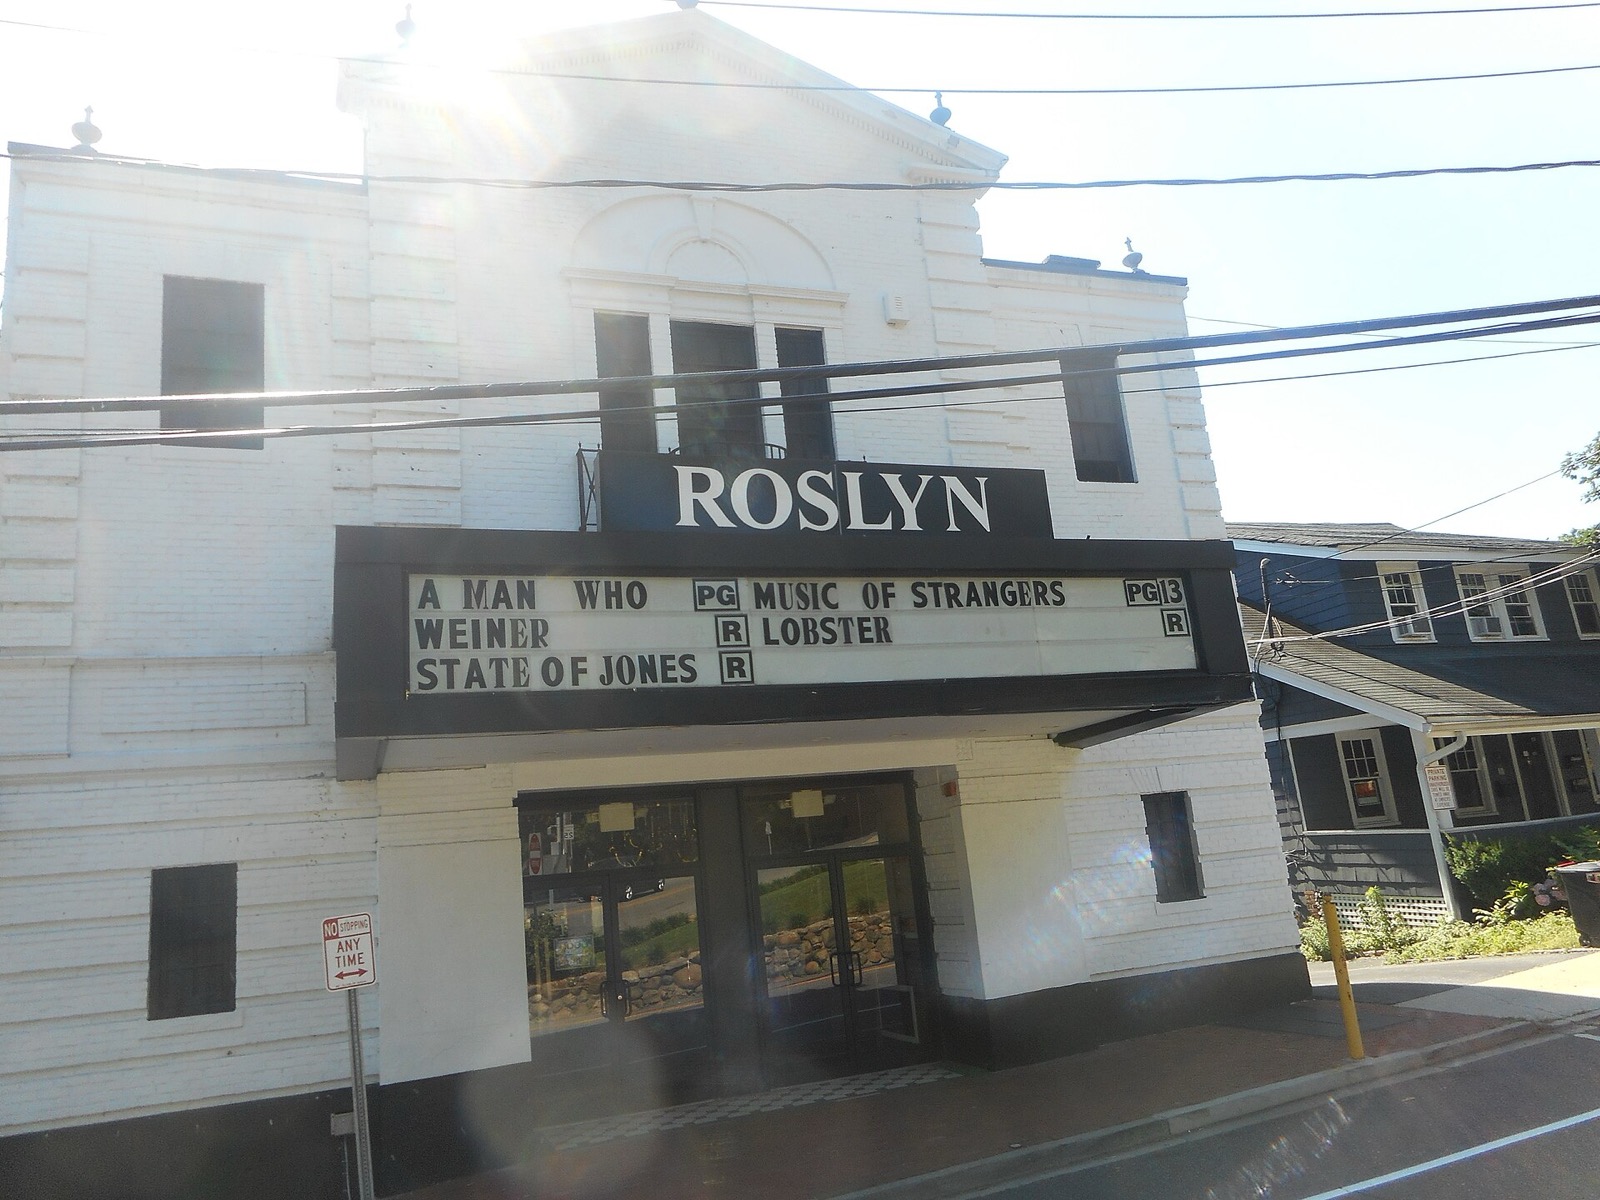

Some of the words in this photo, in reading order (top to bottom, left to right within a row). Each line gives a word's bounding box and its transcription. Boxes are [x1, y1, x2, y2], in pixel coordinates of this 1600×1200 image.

[673, 465, 991, 533] ROSLYN
[418, 578, 440, 610] A
[462, 578, 536, 610] MAN
[573, 581, 647, 609] WHO
[696, 583, 736, 607] PG
[754, 581, 838, 611] MUSIC
[862, 582, 895, 609] OF
[911, 579, 1066, 609] STRANGERS
[414, 618, 548, 649] WEINER
[722, 621, 742, 642] R
[763, 617, 892, 645] LOBSTER
[1165, 612, 1185, 633] R
[416, 658, 530, 691] STATE
[541, 657, 587, 687] OF
[600, 653, 698, 687] JONES
[726, 657, 746, 678] R
[324, 922, 338, 937] NO
[340, 919, 368, 932] STOPPING
[335, 952, 365, 968] TIME
[337, 938, 360, 953] ANY
